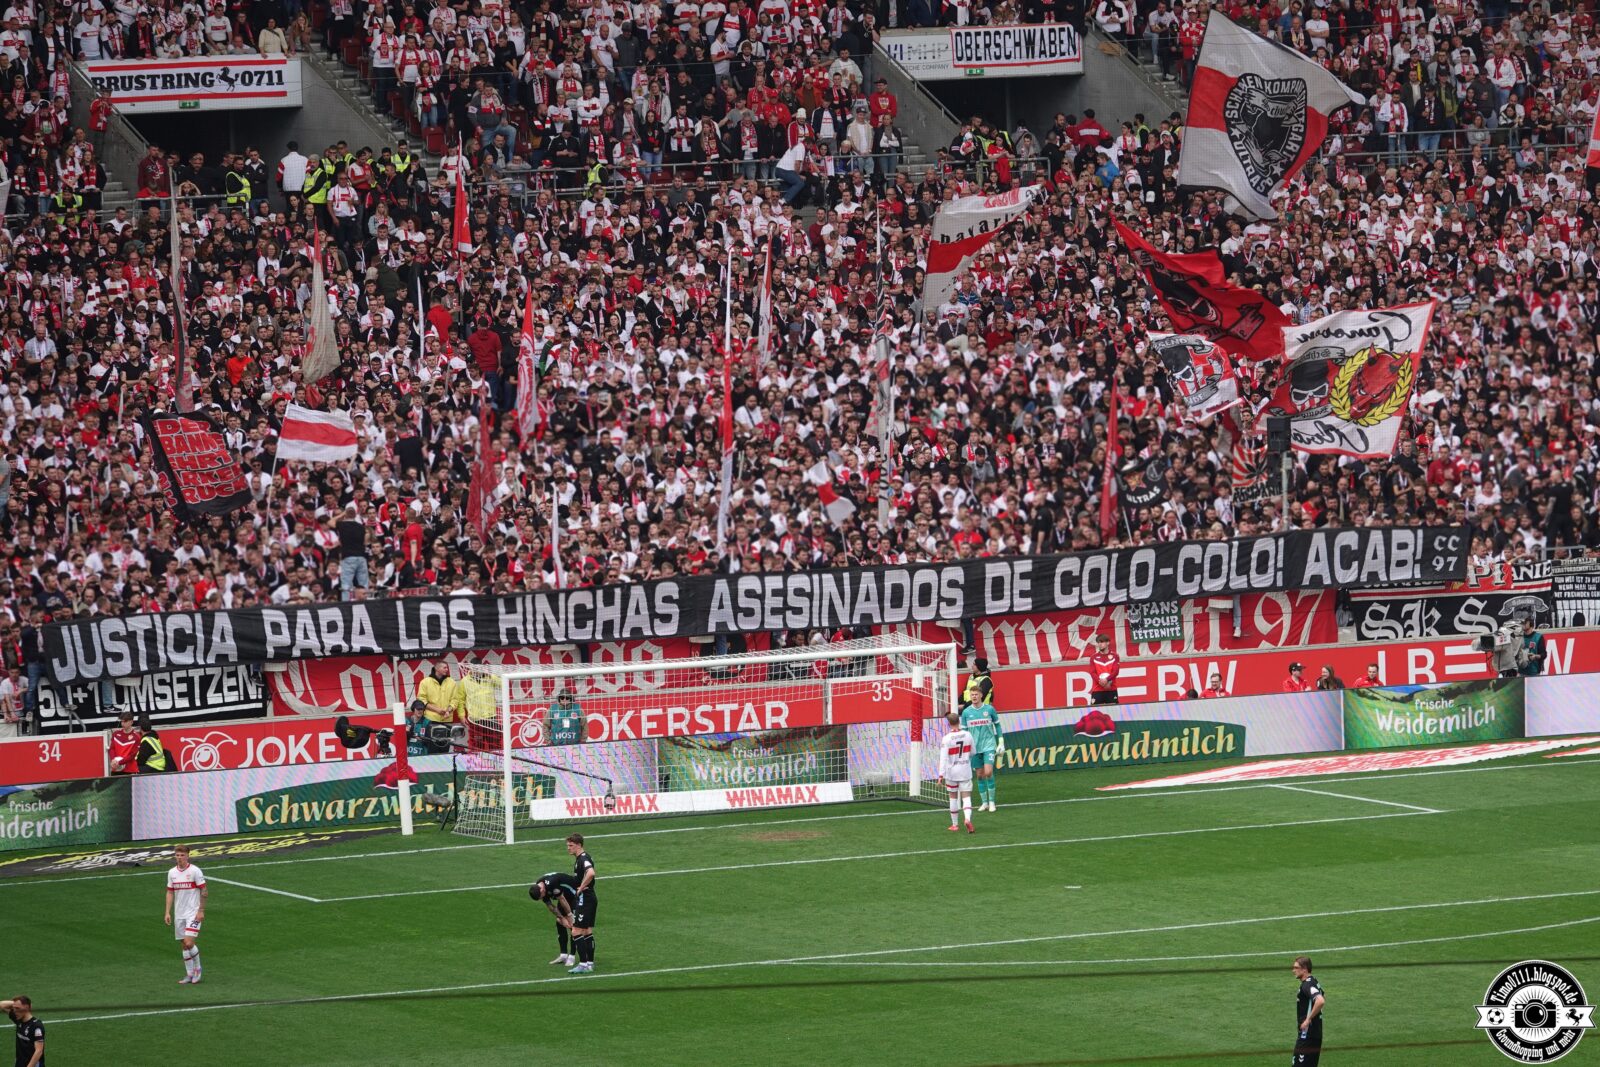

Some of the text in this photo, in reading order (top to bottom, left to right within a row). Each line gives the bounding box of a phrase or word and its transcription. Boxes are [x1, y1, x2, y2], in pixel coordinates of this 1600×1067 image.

[954, 26, 1078, 62] OBERSCHWABEN
[91, 69, 285, 93] BRUSTRING 0711
[1126, 486, 1161, 504] ULTRAS
[1433, 534, 1461, 551] CC
[1431, 555, 1459, 572] 97
[51, 529, 1424, 683] JUSTICIA PARA LOS HINCHAS ASESINADOS DE COLO-COLO! ACAB!
[1142, 600, 1179, 616] FANS
[1143, 615, 1179, 628] POUR
[1253, 588, 1325, 649] 97
[871, 681, 893, 702] 35
[1414, 698, 1454, 710] frische
[584, 701, 790, 742] OKERSTAR
[1375, 702, 1496, 735] Weidemilch
[555, 731, 577, 740] HOST
[38, 741, 62, 764] 34
[732, 746, 774, 758] frische
[956, 741, 964, 758] 7
[995, 725, 1236, 770] warzwaldmilch
[691, 751, 817, 783] Weidemilch
[9, 800, 54, 813] frische
[566, 794, 660, 817] WINAMAX
[725, 785, 820, 808] WINAMAX
[0, 803, 99, 839] idemilch
